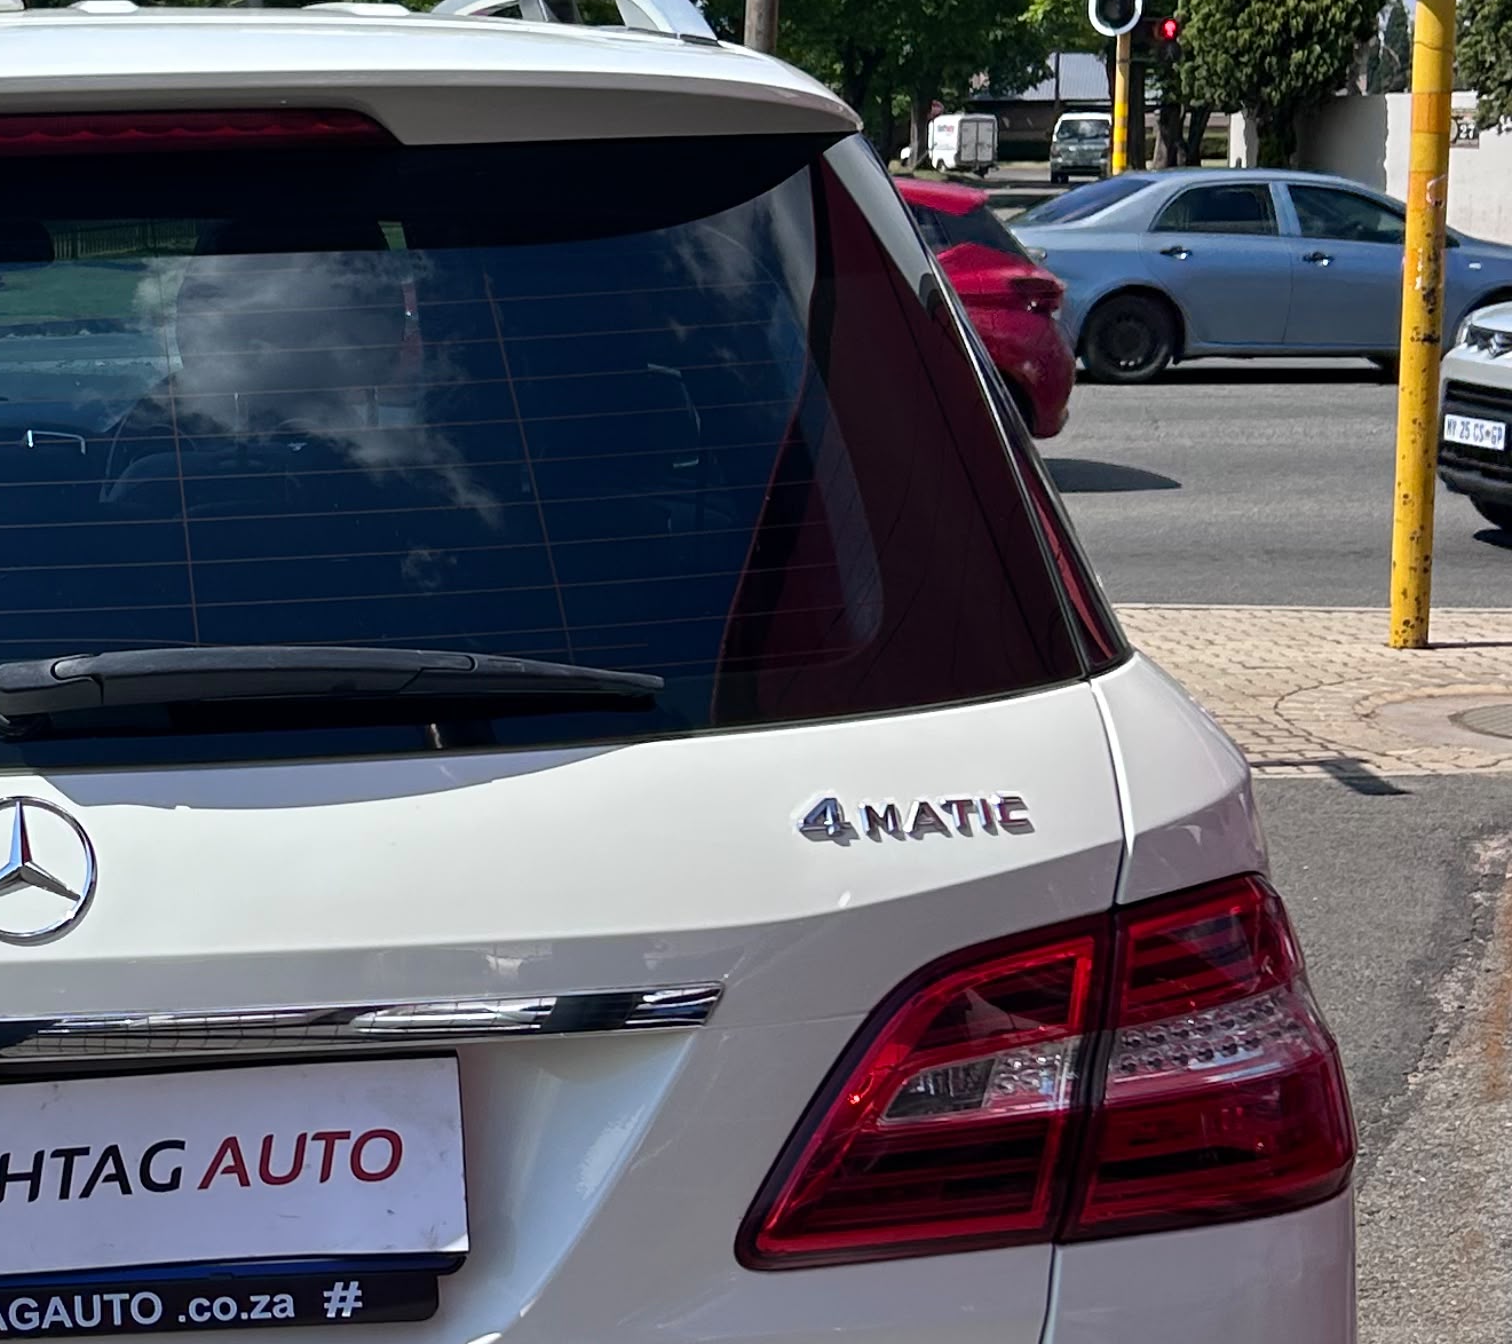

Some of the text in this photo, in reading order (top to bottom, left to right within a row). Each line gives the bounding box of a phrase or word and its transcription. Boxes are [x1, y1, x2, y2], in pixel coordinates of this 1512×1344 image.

[1459, 421, 1470, 440] 25
[1491, 426, 1502, 445] GP
[197, 1128, 404, 1191] AUTO
[177, 1293, 295, 1323] .co.za
